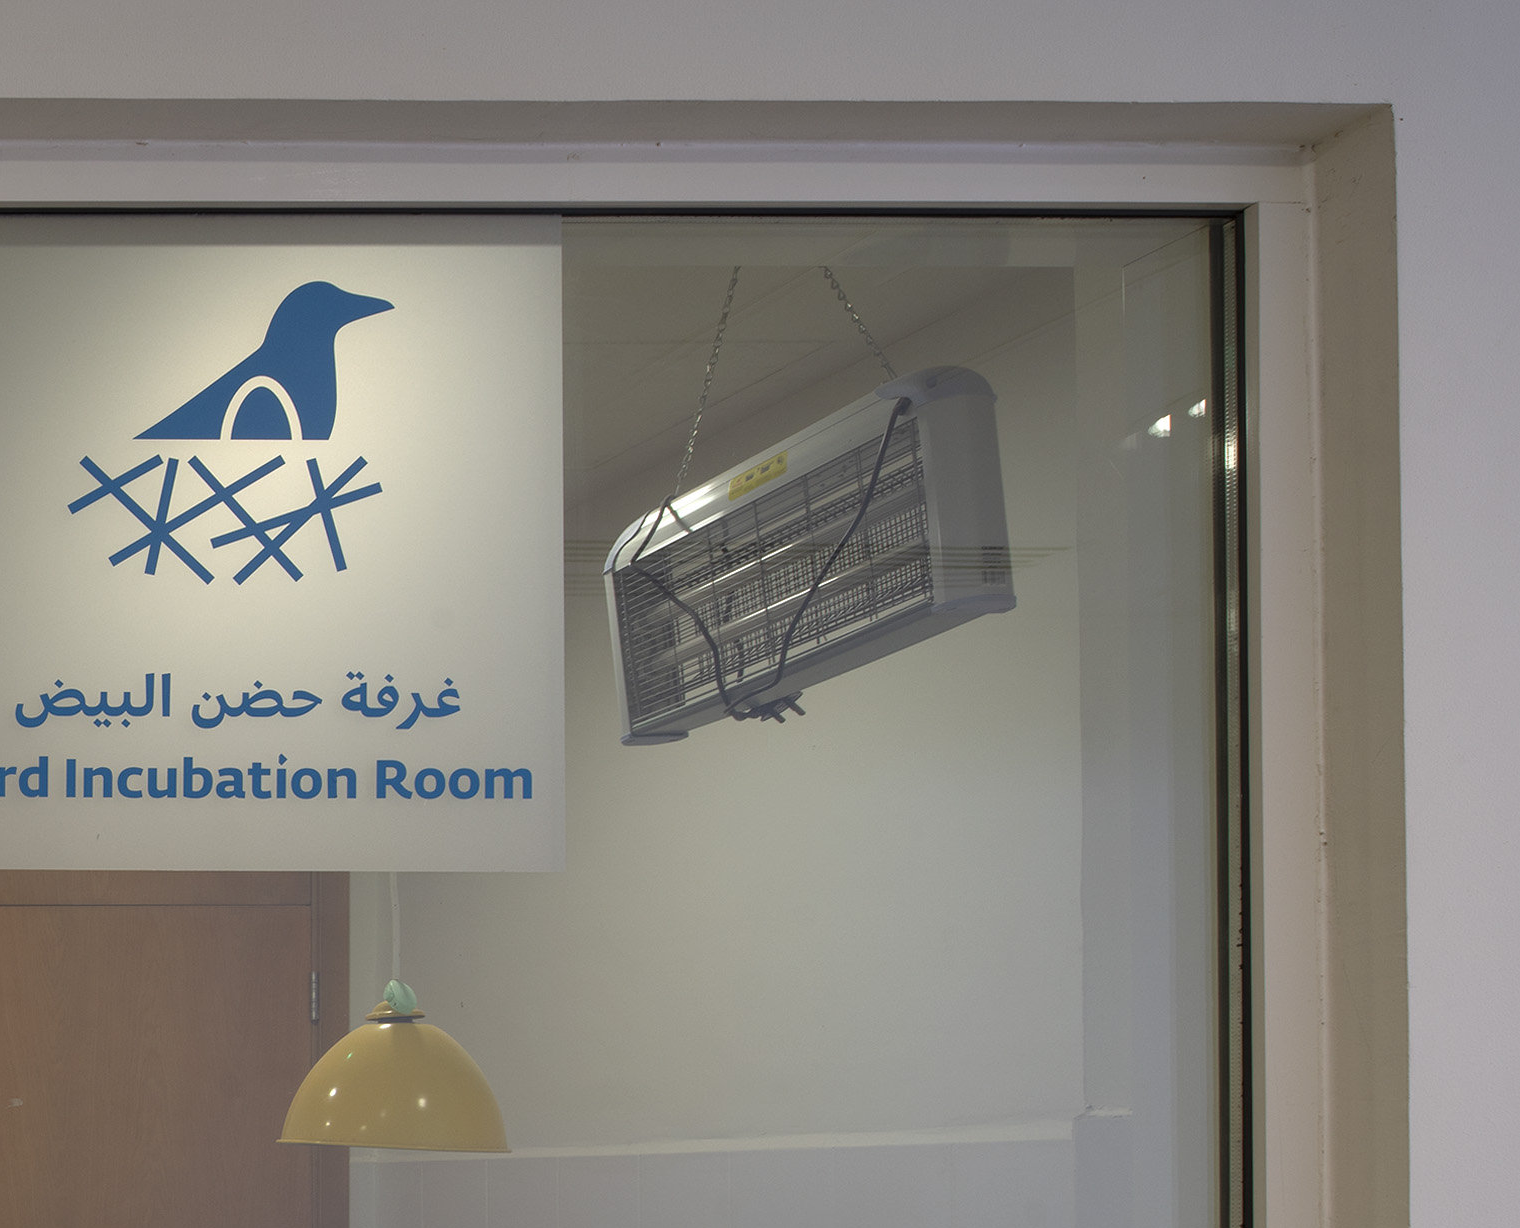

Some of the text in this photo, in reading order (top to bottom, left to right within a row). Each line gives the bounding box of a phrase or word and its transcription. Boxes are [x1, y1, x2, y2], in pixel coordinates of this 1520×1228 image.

[15, 672, 460, 729] غرفة حضن البيض
[66, 754, 356, 799] Incubation
[376, 760, 532, 799] Room
